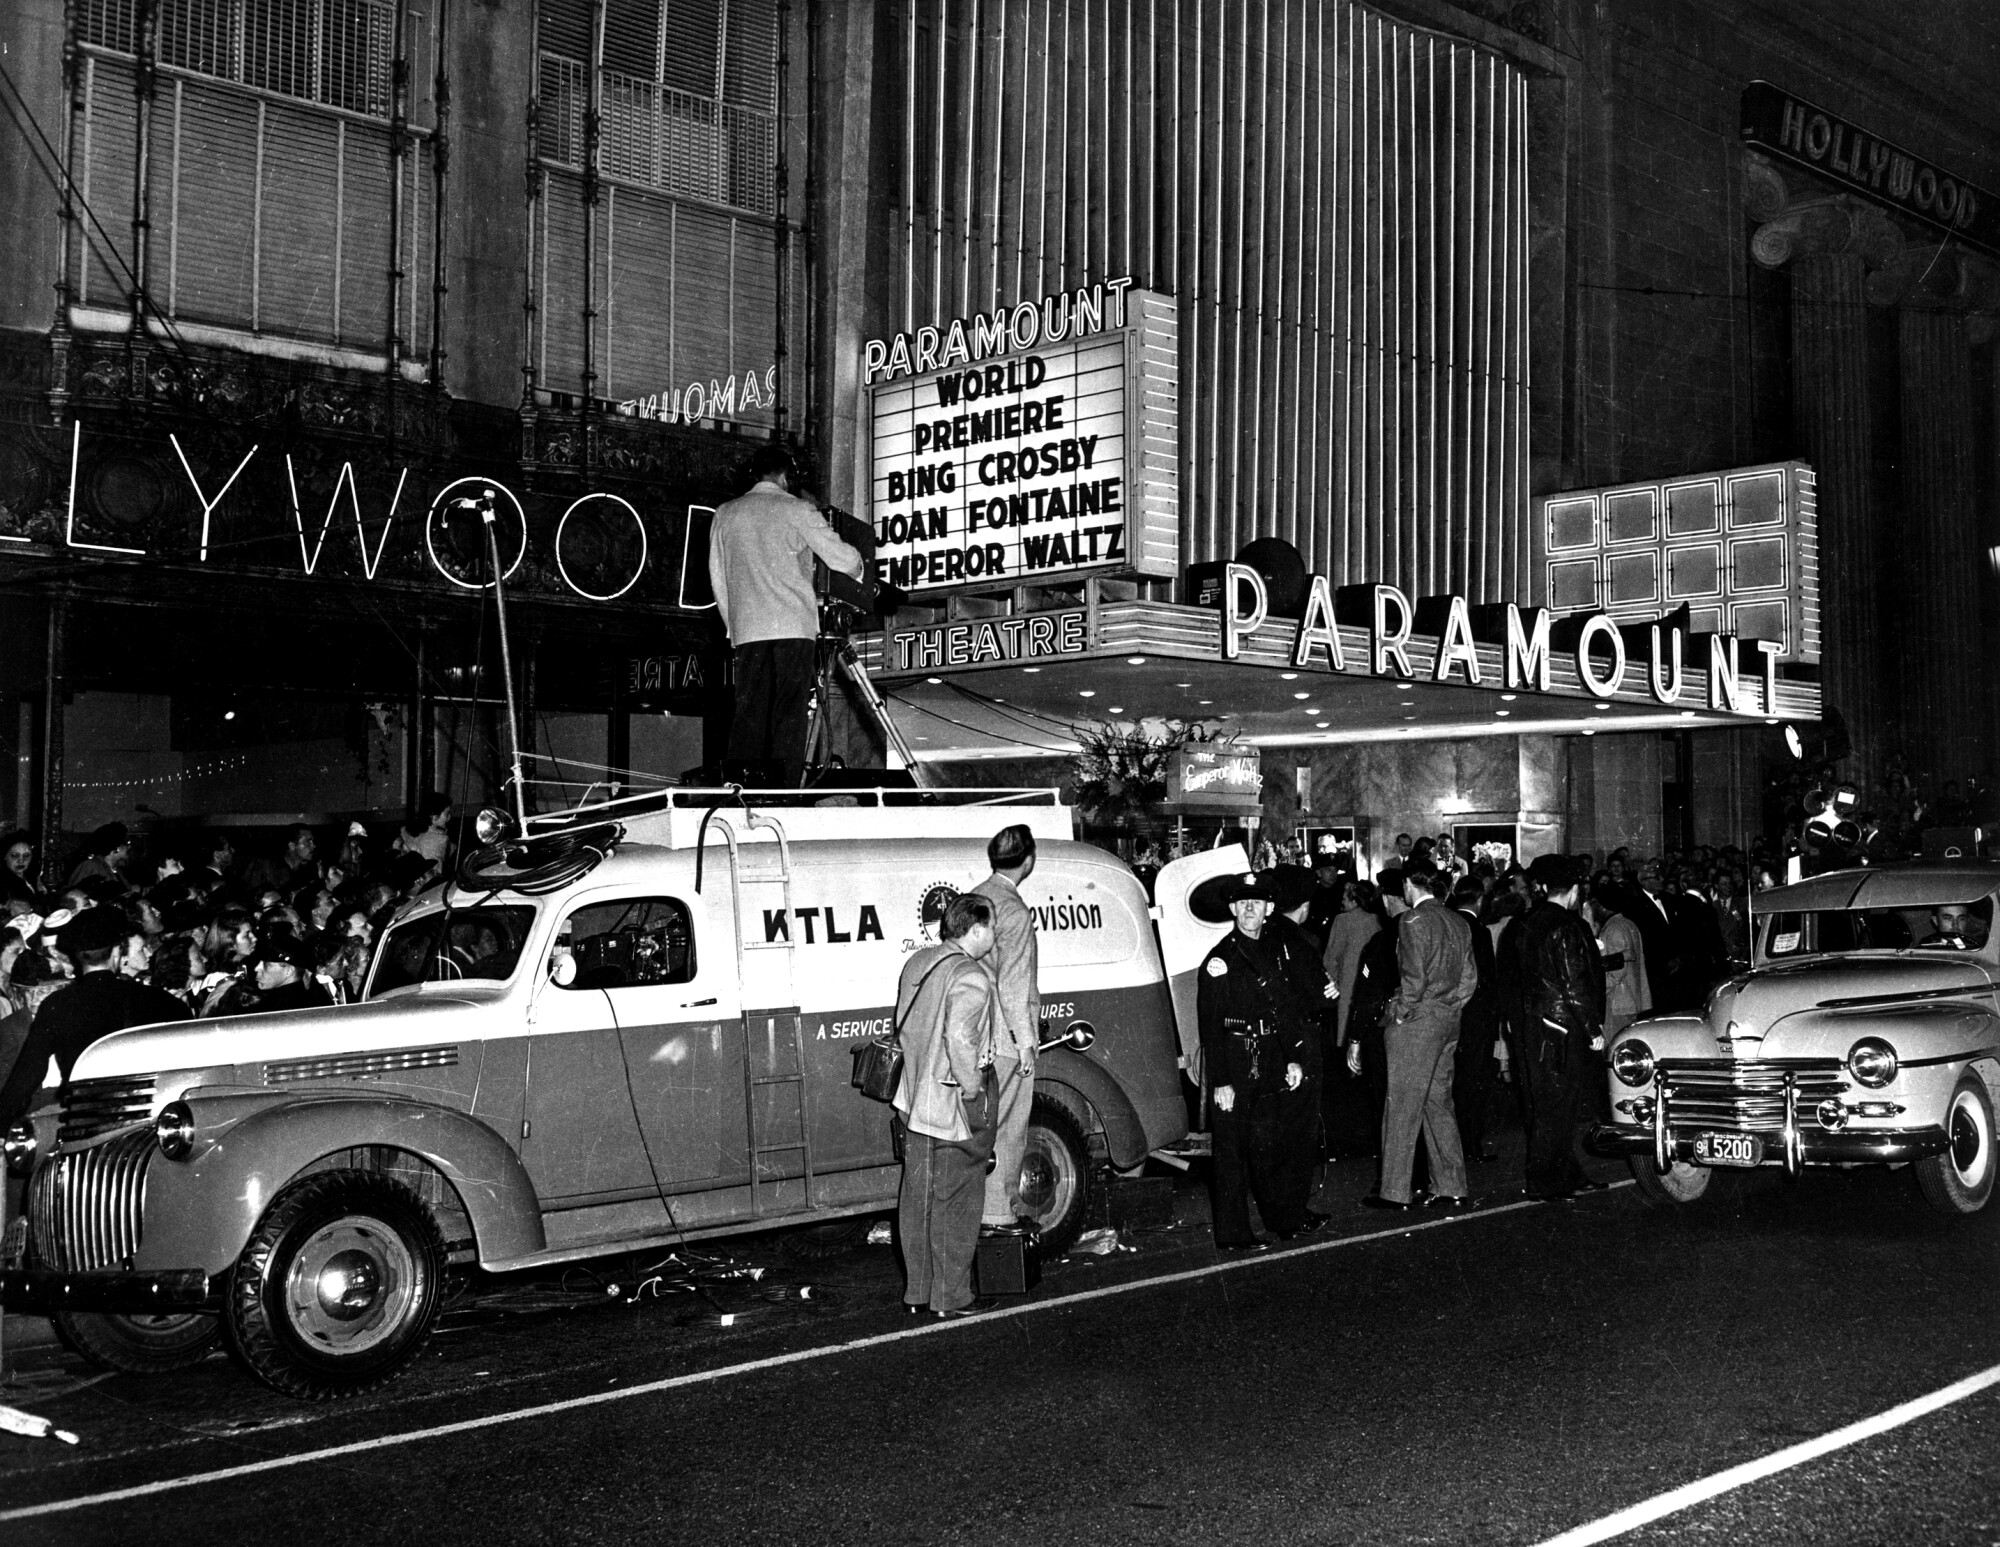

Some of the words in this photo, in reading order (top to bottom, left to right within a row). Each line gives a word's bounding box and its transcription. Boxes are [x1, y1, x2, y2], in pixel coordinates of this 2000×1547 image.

[1780, 98, 1977, 229] HOLLYWOOD
[864, 276, 1132, 385] PARAMOUNT
[936, 355, 1046, 408] WORLD
[915, 394, 1063, 456] PREMIERE
[889, 461, 956, 503] BING
[978, 434, 1098, 487] CROSBY
[875, 505, 948, 548] JOAN
[969, 476, 1121, 533] FONTAINE
[875, 541, 1006, 588] EMPEROR
[1022, 523, 1126, 570] WALTZ
[893, 612, 1083, 670] THEATRE
[1224, 562, 1785, 716] PARAMOUNT
[1185, 764, 1231, 792] Emperor
[1197, 752, 1216, 763] THE
[762, 904, 885, 945] KTLA
[816, 1023, 827, 1041] A
[830, 1017, 892, 1040] SERVICE
[1713, 1138, 1753, 1161] 5200
